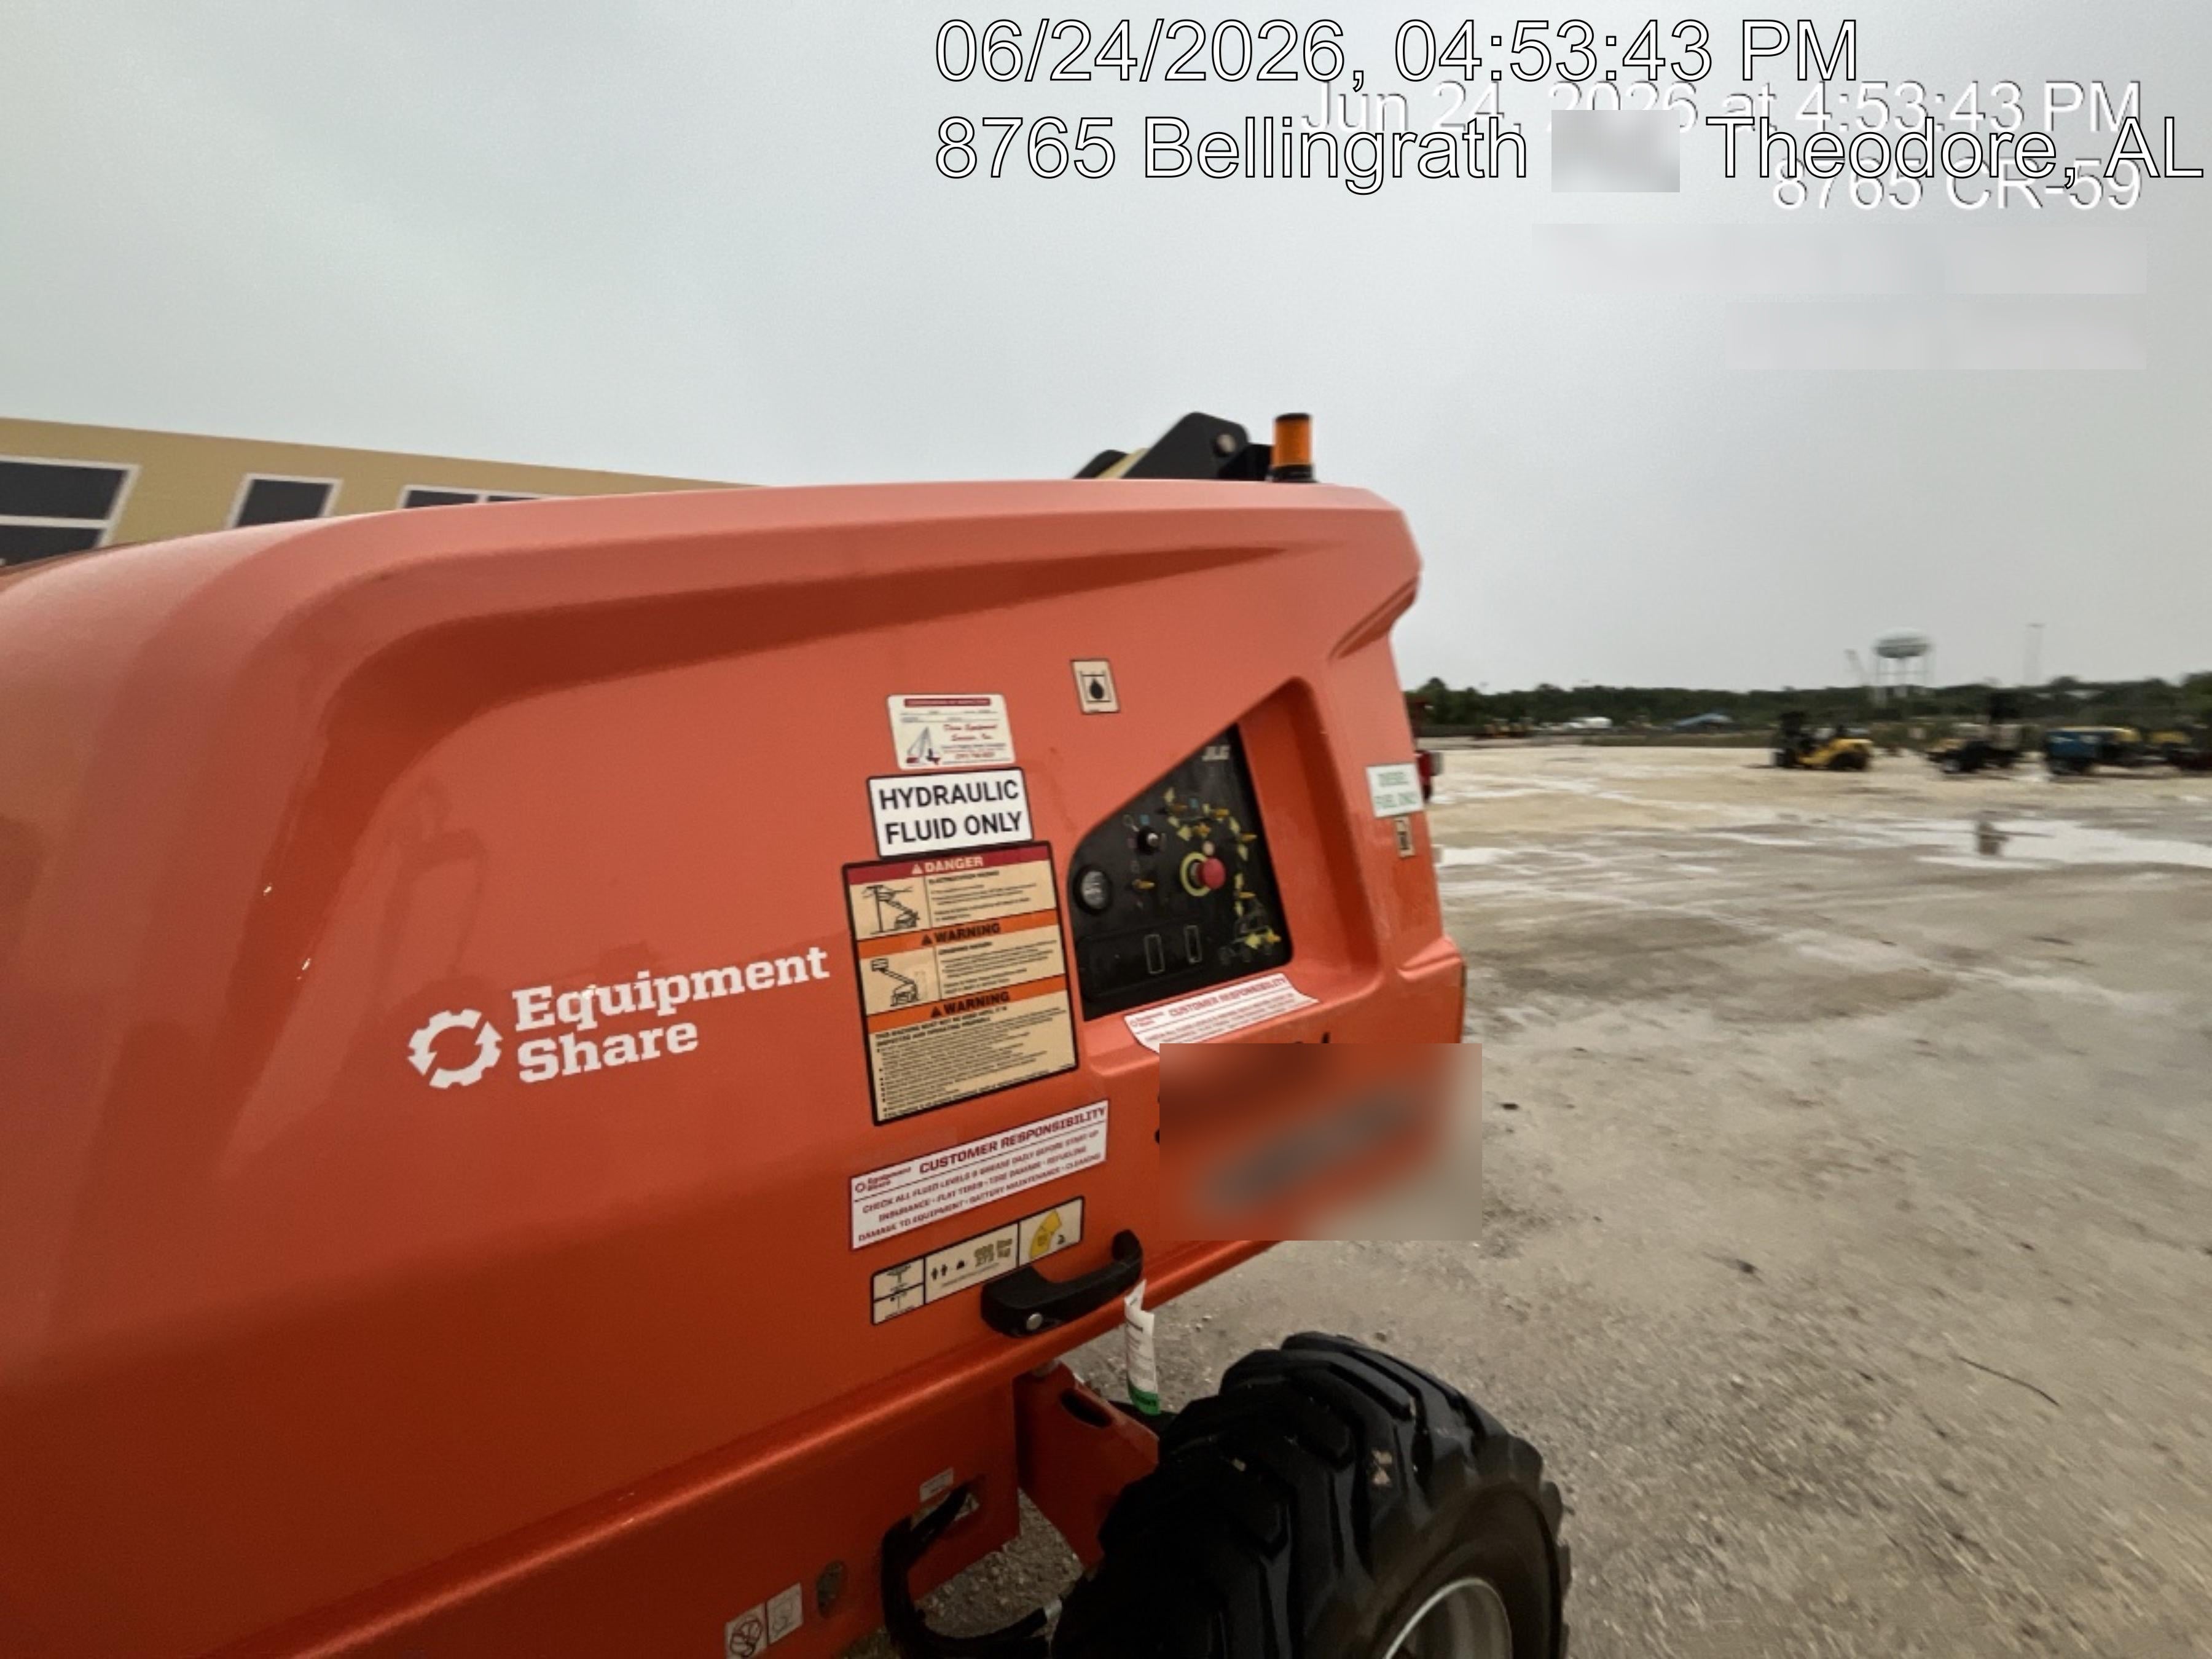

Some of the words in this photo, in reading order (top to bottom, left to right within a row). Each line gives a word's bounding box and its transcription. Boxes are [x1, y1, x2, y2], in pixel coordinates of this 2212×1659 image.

[879, 779, 1019, 810] HYDRAULIC
[885, 818, 957, 844] FLUID
[964, 810, 1022, 835] ONLY
[924, 856, 984, 874] DANGER
[935, 923, 1001, 943] WARNING
[512, 946, 830, 1031] Equipment
[944, 991, 1010, 1015] WARNING
[517, 1022, 699, 1083] Share
[919, 1140, 998, 1174] CUSTOMER
[1000, 1107, 1105, 1149] RESPONSIBILITY
[862, 1199, 893, 1214] CHECK
[895, 1192, 910, 1202] ALL
